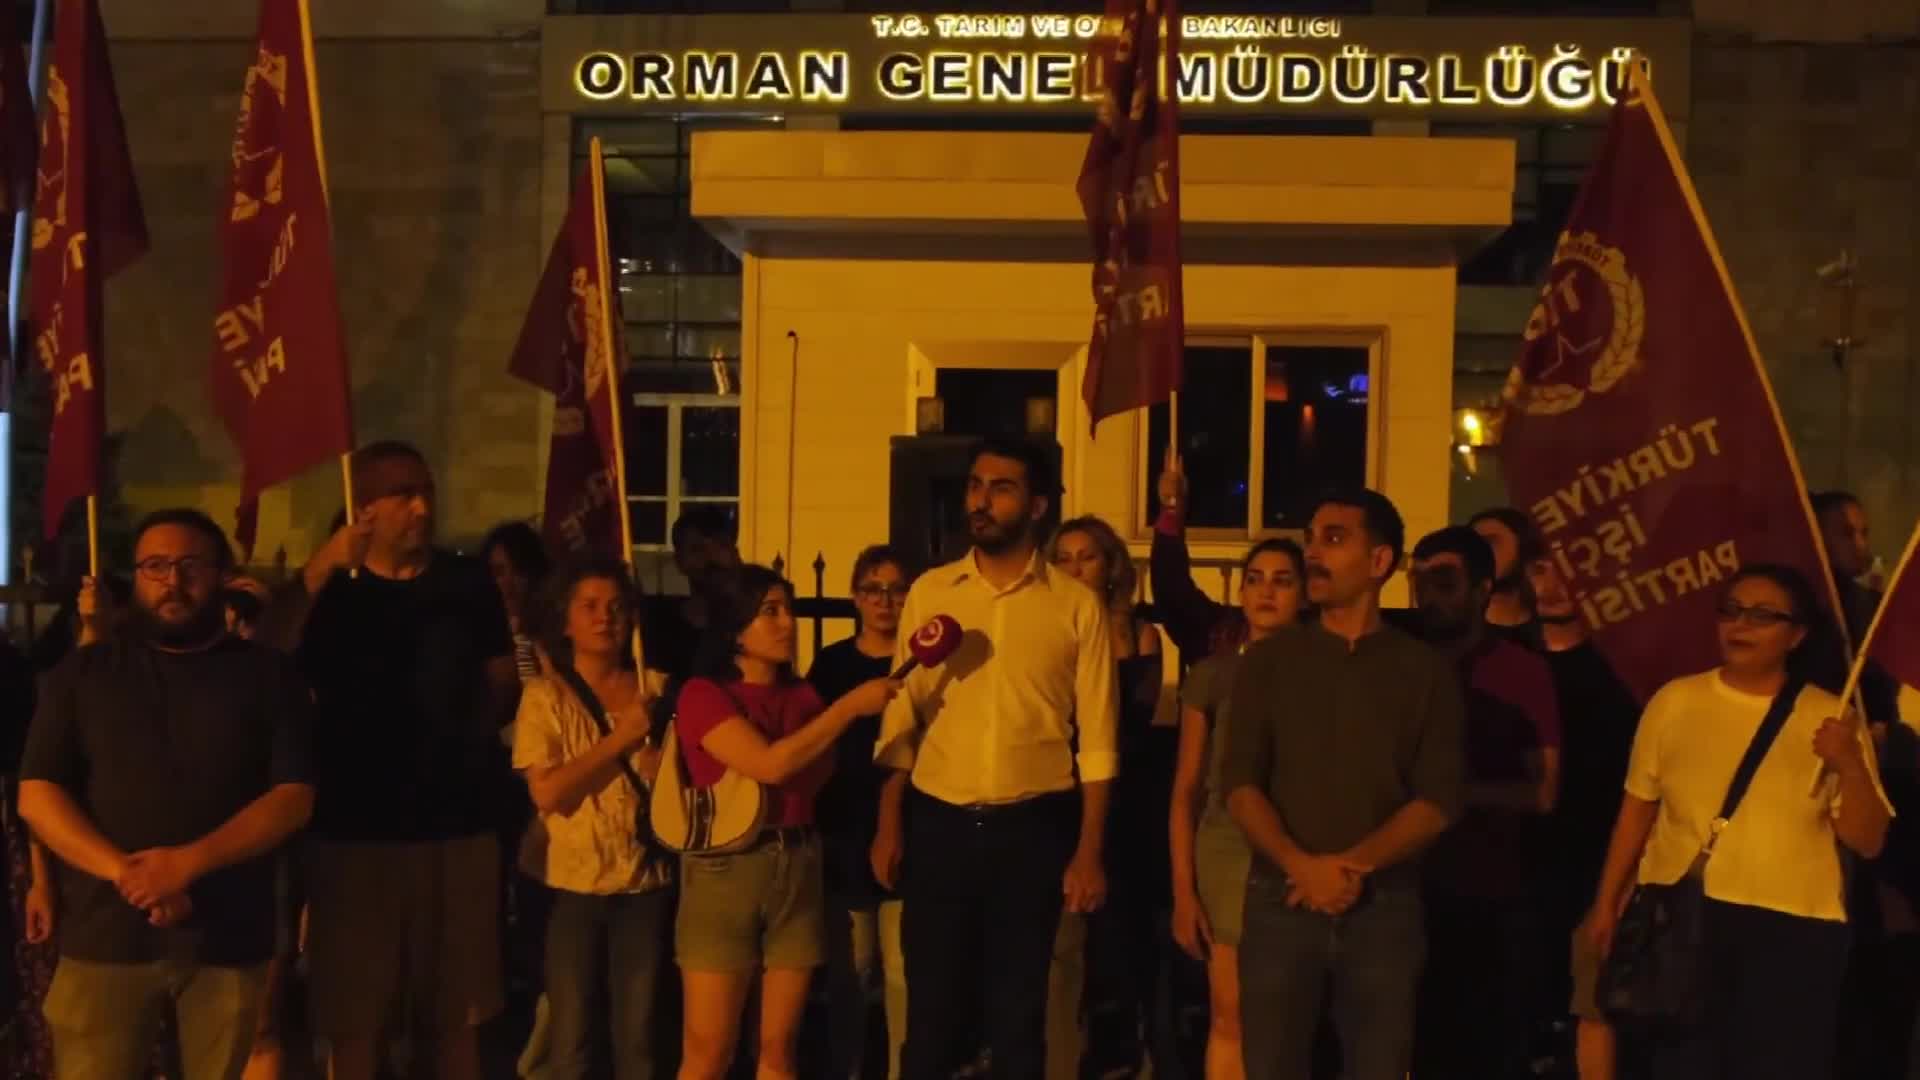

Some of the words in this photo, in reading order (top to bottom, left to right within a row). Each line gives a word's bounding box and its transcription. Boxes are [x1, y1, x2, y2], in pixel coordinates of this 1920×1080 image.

[872, 15, 929, 37] T.C.
[934, 15, 1025, 38] TARIM
[1031, 15, 1070, 37] VE
[575, 51, 848, 100] ORMAN
